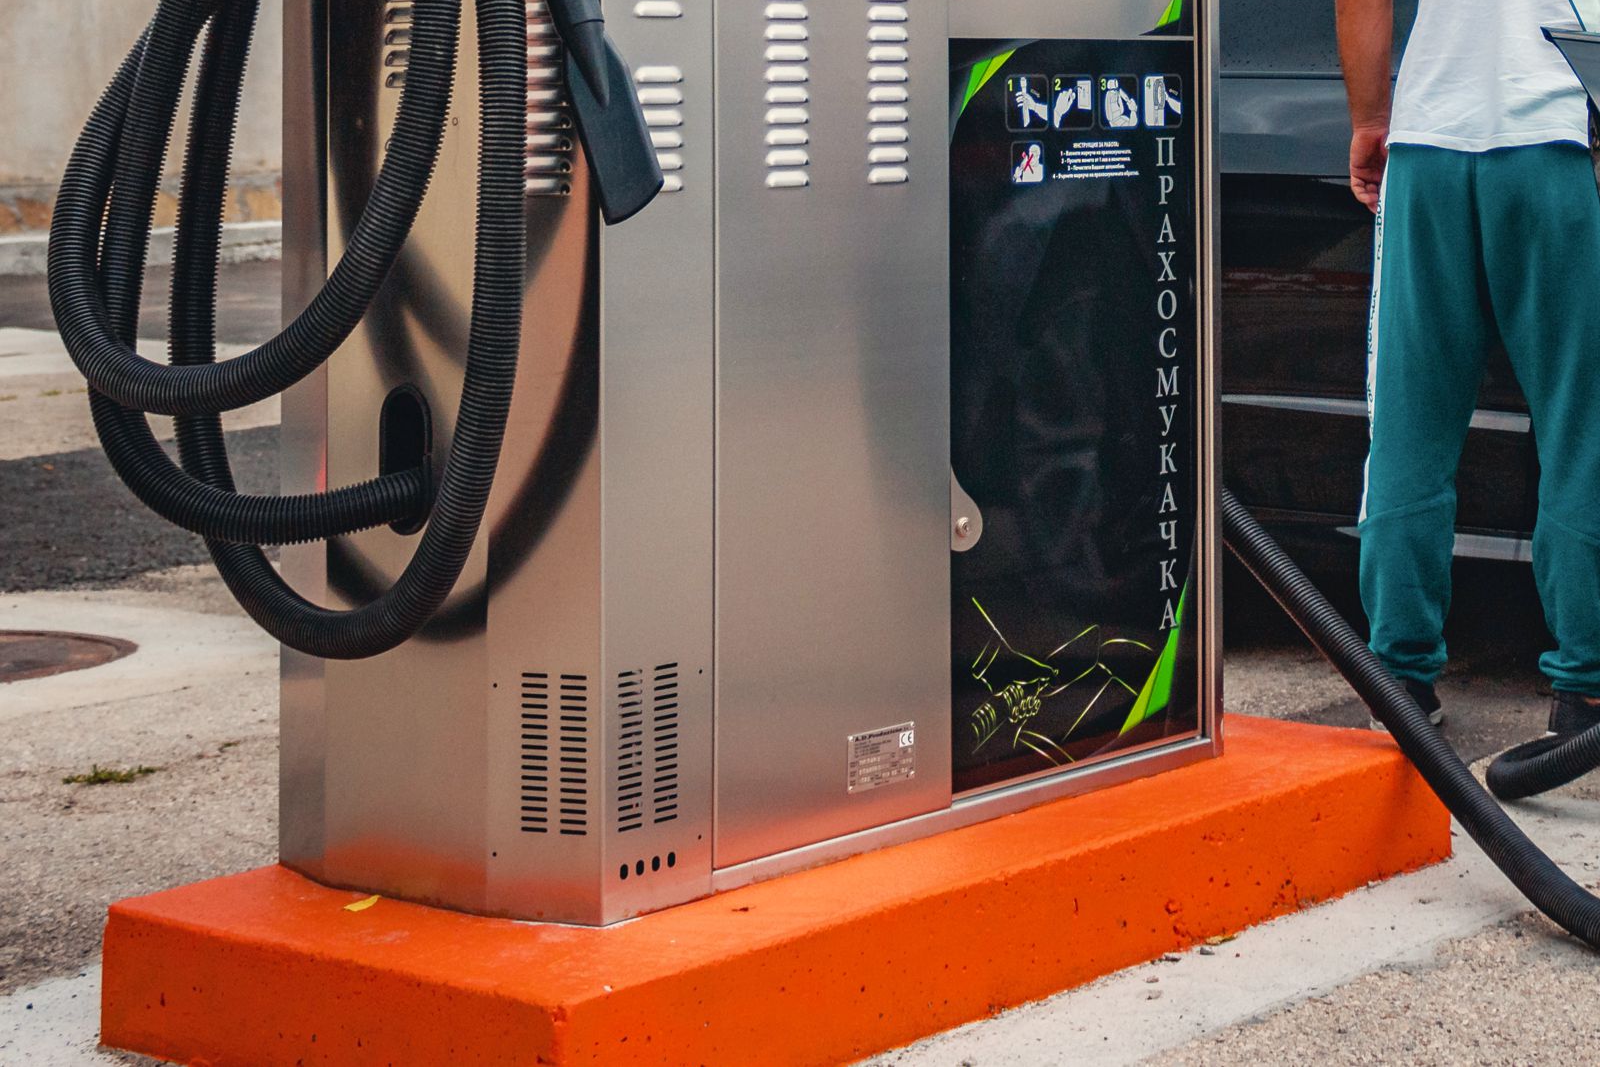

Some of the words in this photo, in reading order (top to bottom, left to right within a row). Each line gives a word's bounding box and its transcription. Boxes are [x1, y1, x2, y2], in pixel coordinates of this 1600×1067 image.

[1007, 79, 1013, 92] 1
[1054, 78, 1061, 91] 2
[1100, 78, 1107, 90] 3
